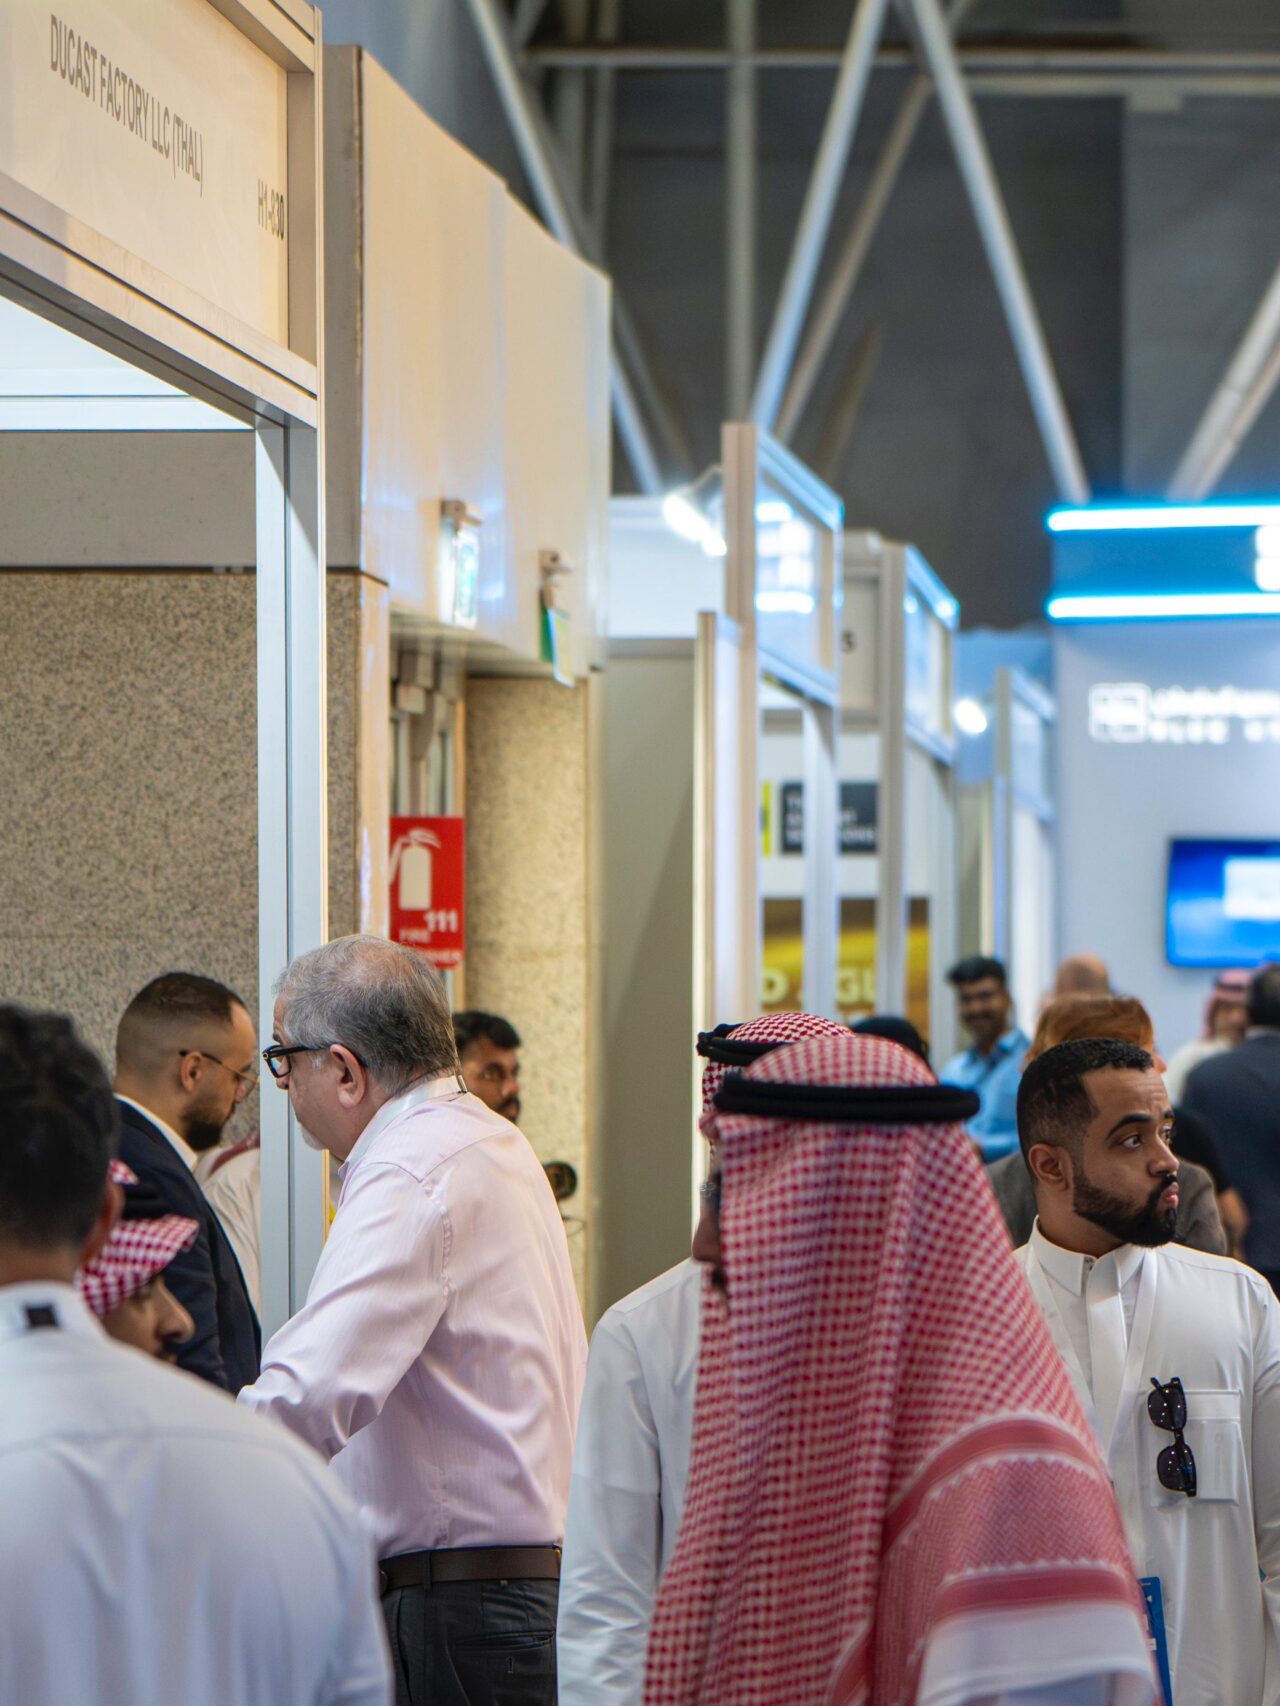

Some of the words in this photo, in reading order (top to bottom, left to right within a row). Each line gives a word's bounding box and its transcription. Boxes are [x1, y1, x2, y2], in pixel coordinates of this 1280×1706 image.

[50, 13, 98, 102] DUCAST
[100, 53, 149, 143] FACTORY
[151, 96, 170, 159] LLC
[172, 113, 204, 199] (THAL)
